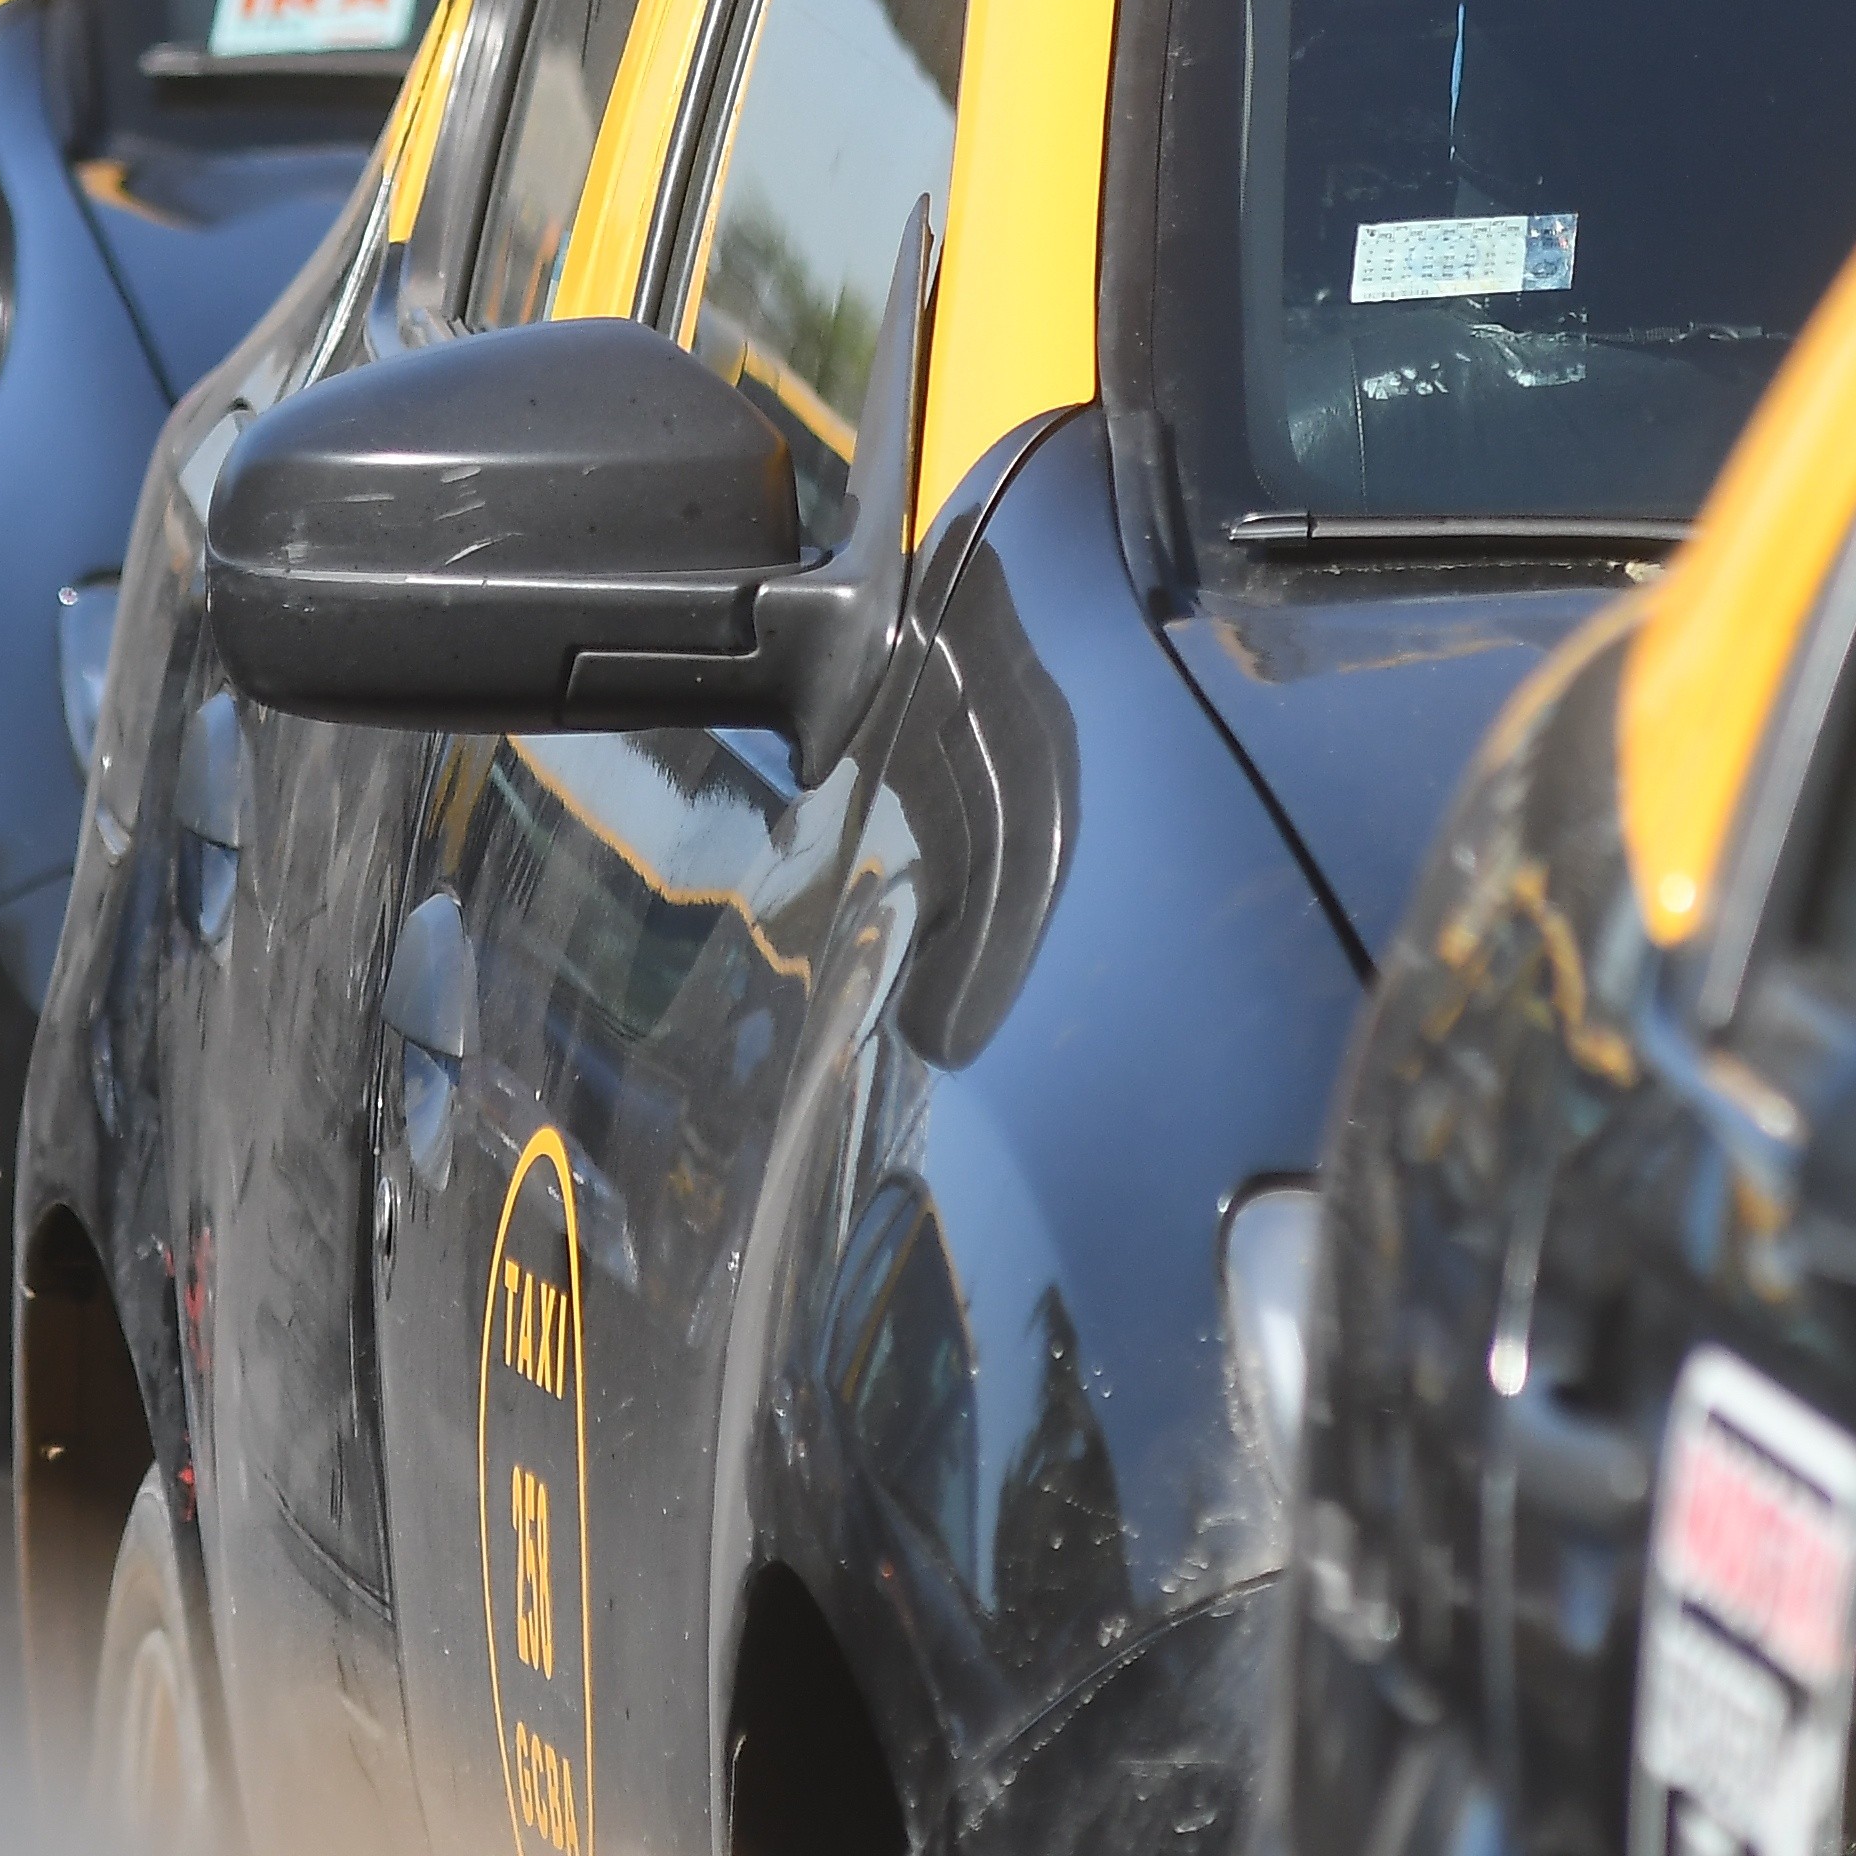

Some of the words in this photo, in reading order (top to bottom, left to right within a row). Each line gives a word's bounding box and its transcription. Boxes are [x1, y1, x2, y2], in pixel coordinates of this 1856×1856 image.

[505, 1258, 568, 1401] TAXI
[512, 1465, 553, 1682] 258
[516, 1721, 580, 1856] GCBA
